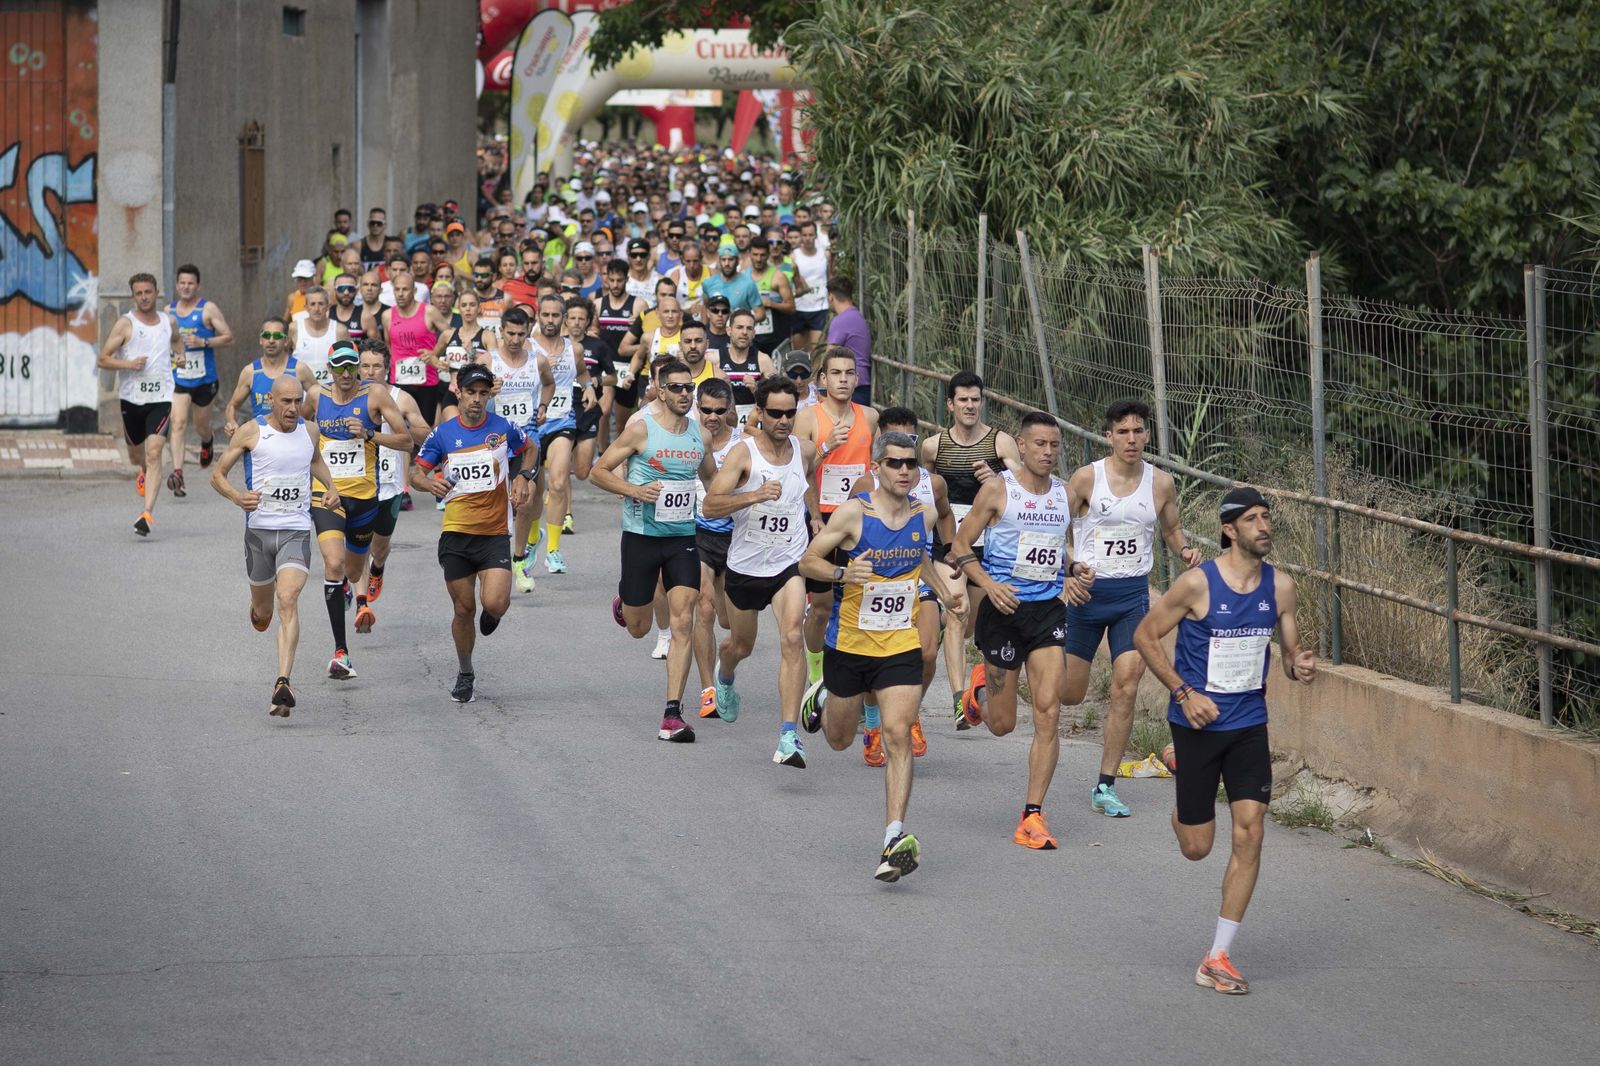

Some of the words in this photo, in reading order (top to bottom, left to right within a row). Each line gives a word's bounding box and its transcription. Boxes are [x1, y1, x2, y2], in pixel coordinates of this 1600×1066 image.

[708, 66, 771, 84] Radler
[400, 365, 420, 375] 843
[140, 381, 161, 393] 825
[502, 403, 527, 416] 813
[330, 451, 357, 465] 597
[841, 478, 851, 492] 3
[271, 488, 300, 501] 483
[664, 493, 691, 508] 803
[759, 515, 789, 533] 139
[1017, 512, 1065, 523] MARACENA
[1104, 539, 1137, 557] 735
[1026, 547, 1057, 566] 465
[870, 596, 905, 614] 598
